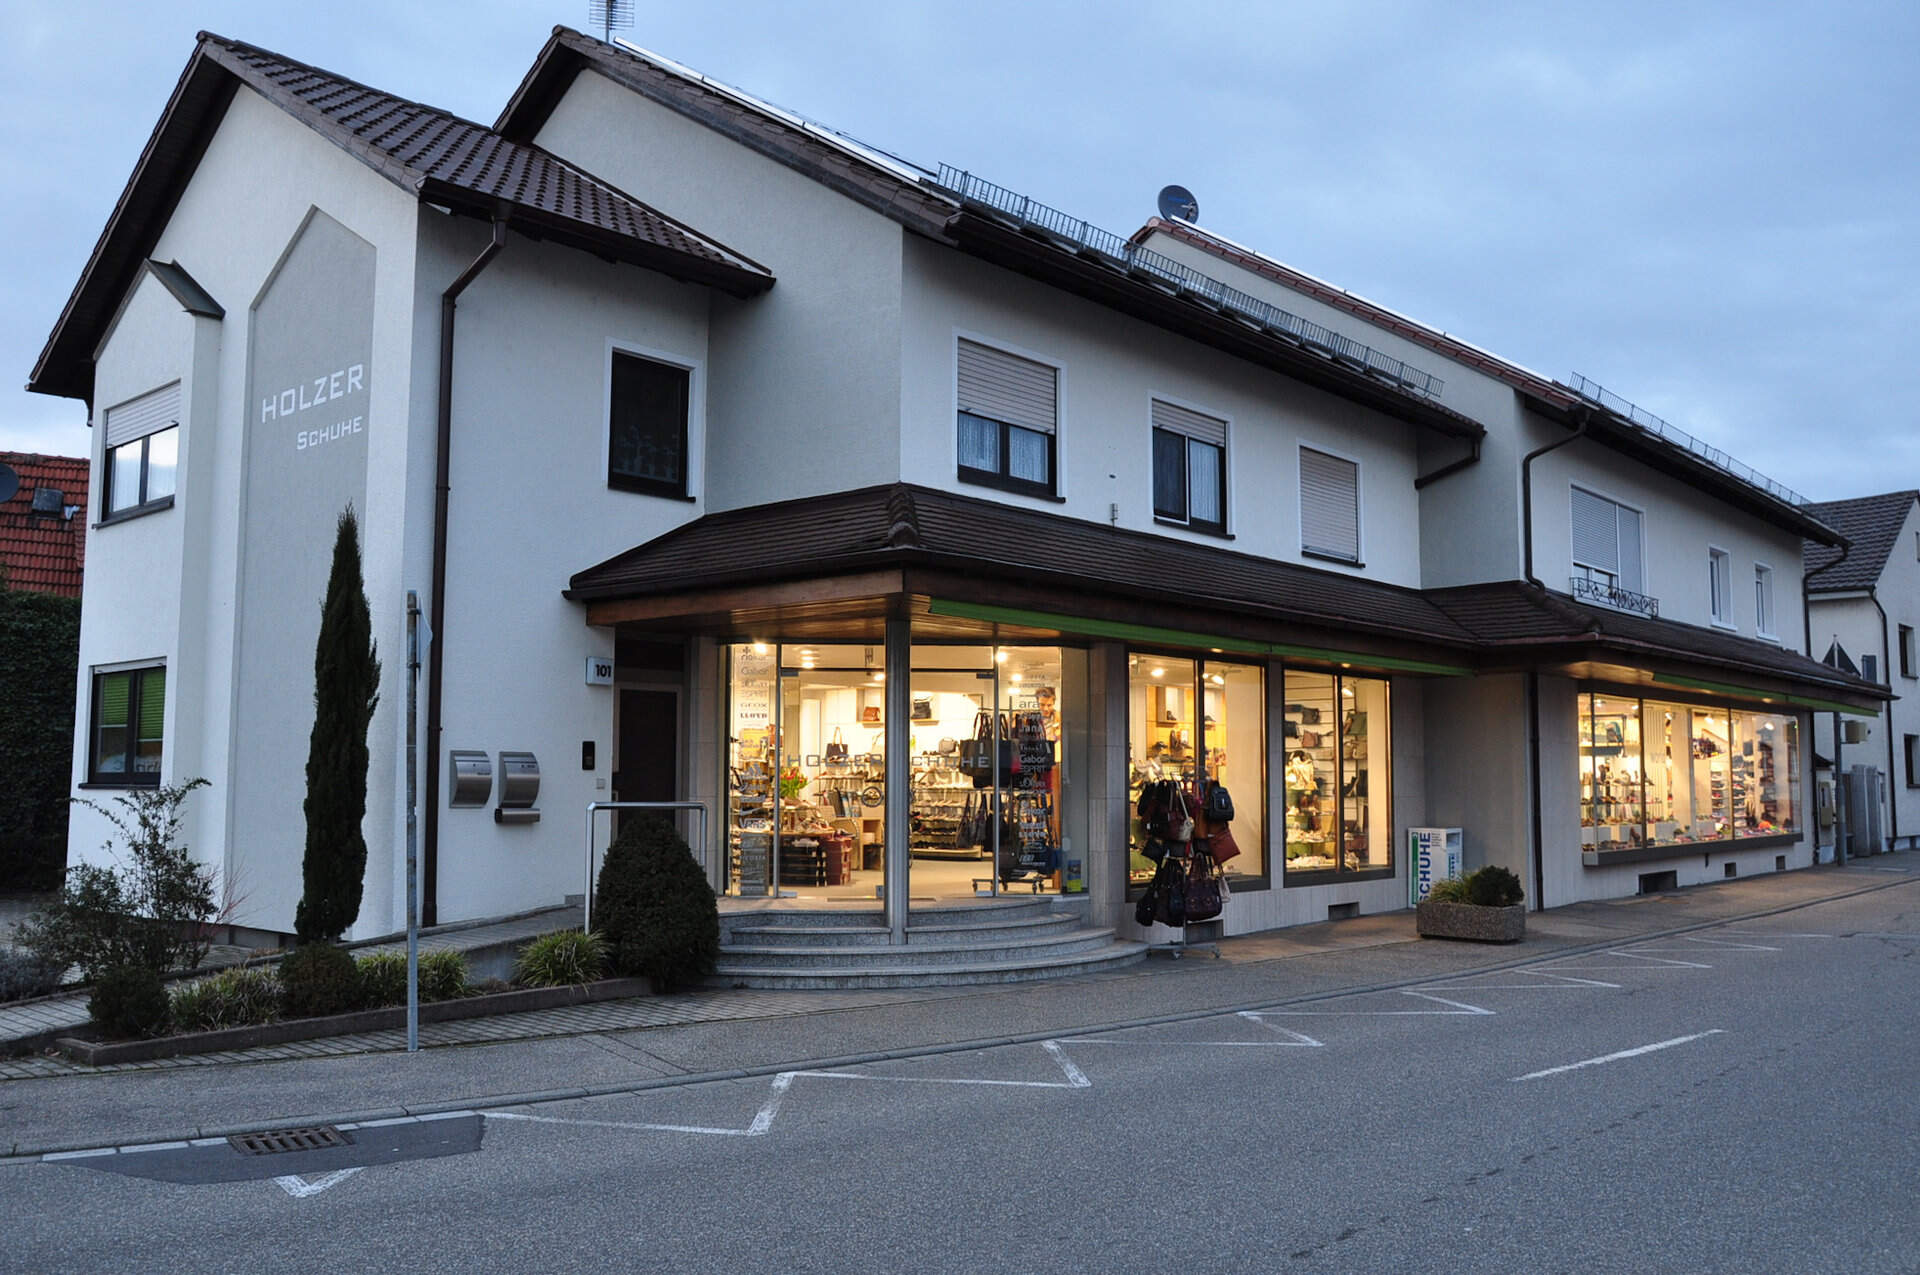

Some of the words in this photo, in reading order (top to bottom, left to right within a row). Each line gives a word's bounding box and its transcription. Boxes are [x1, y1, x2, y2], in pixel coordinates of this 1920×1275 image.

[262, 364, 364, 423] HOLZER
[296, 416, 363, 450] SCHUHE
[596, 664, 612, 678] 101
[1019, 700, 1040, 709] ara
[787, 753, 884, 768] HOLZER
[911, 755, 990, 768] CHUHE
[1020, 754, 1046, 764] Gabor
